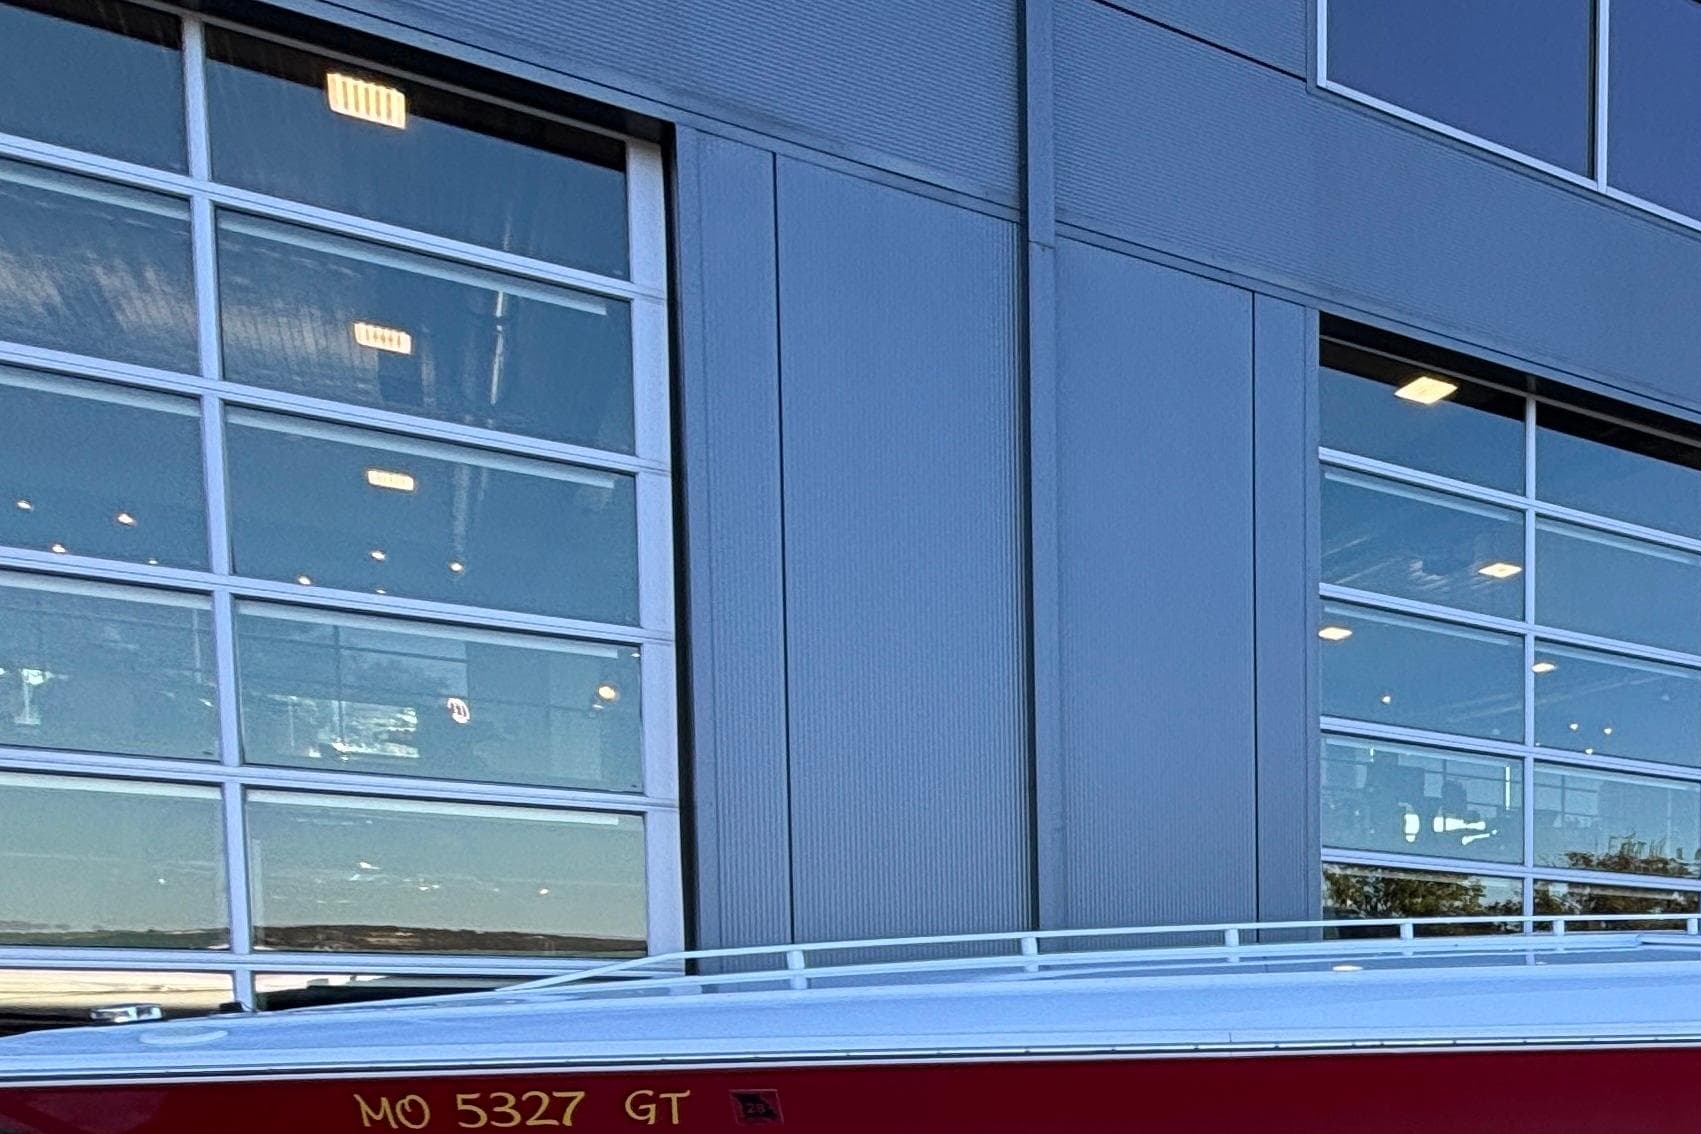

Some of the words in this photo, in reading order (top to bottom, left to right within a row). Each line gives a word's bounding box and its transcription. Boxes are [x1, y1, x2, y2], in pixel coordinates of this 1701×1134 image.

[352, 1093, 432, 1130] MO
[454, 1090, 587, 1129] 5327
[624, 1088, 691, 1126] GT
